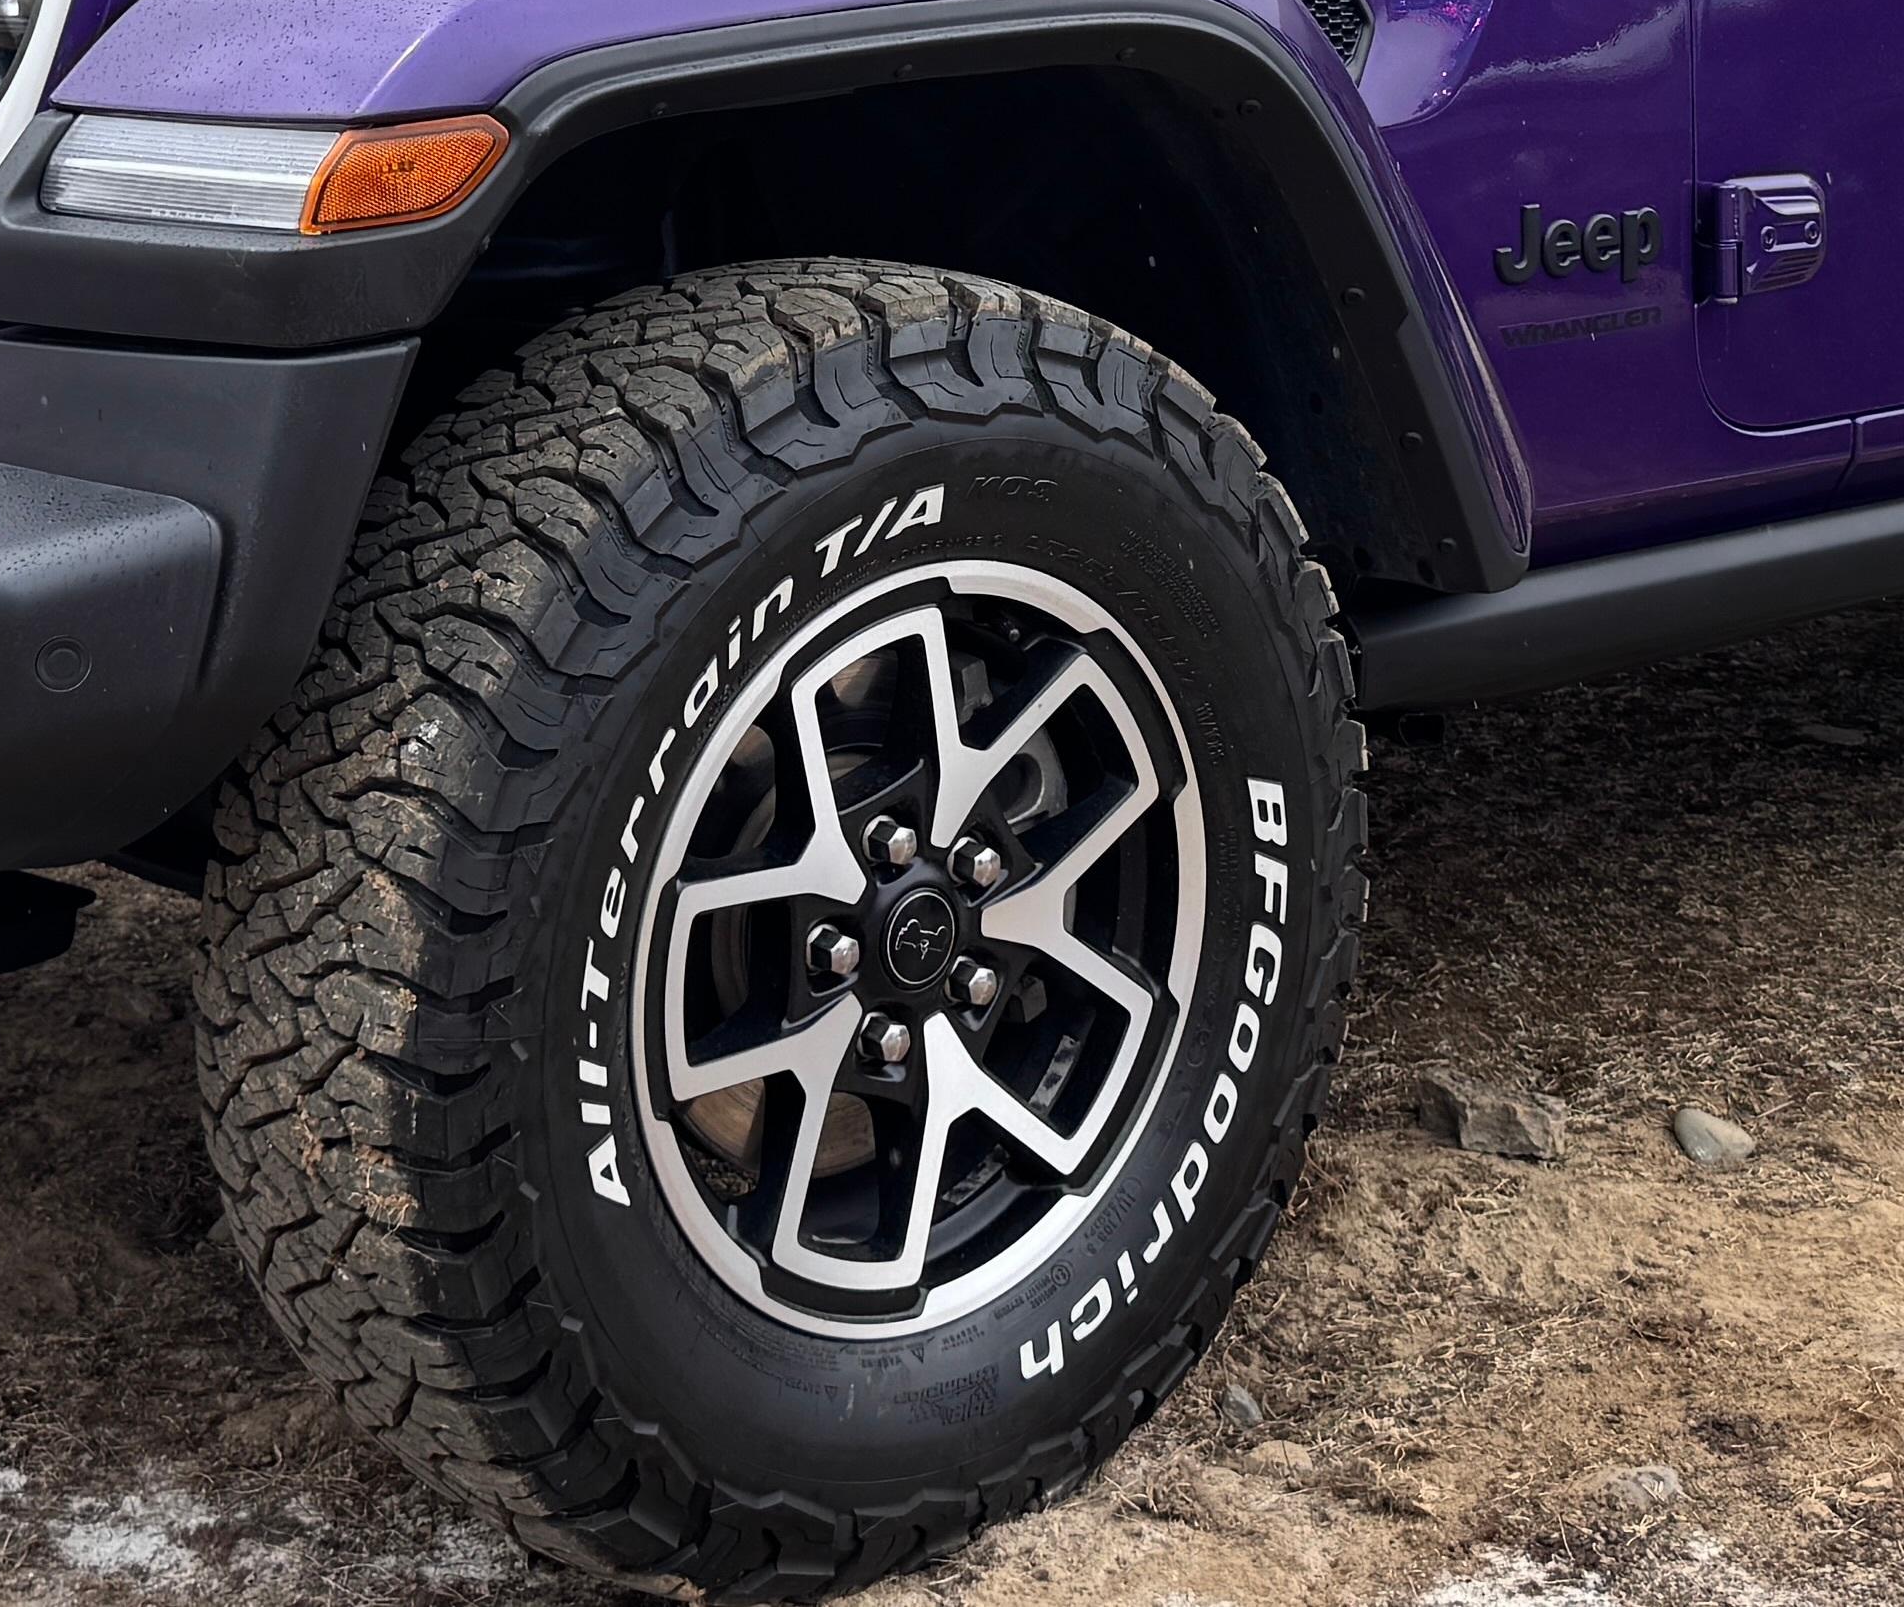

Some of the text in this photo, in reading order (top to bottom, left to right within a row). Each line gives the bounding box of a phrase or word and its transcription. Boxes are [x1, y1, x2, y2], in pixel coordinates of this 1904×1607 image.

[1494, 203, 1662, 285] Jeep
[1499, 306, 1663, 347] WRANGLER
[577, 574, 794, 1208] All-Terrain
[814, 483, 945, 578] T/A
[1018, 776, 1290, 1381] BFGoodrich
